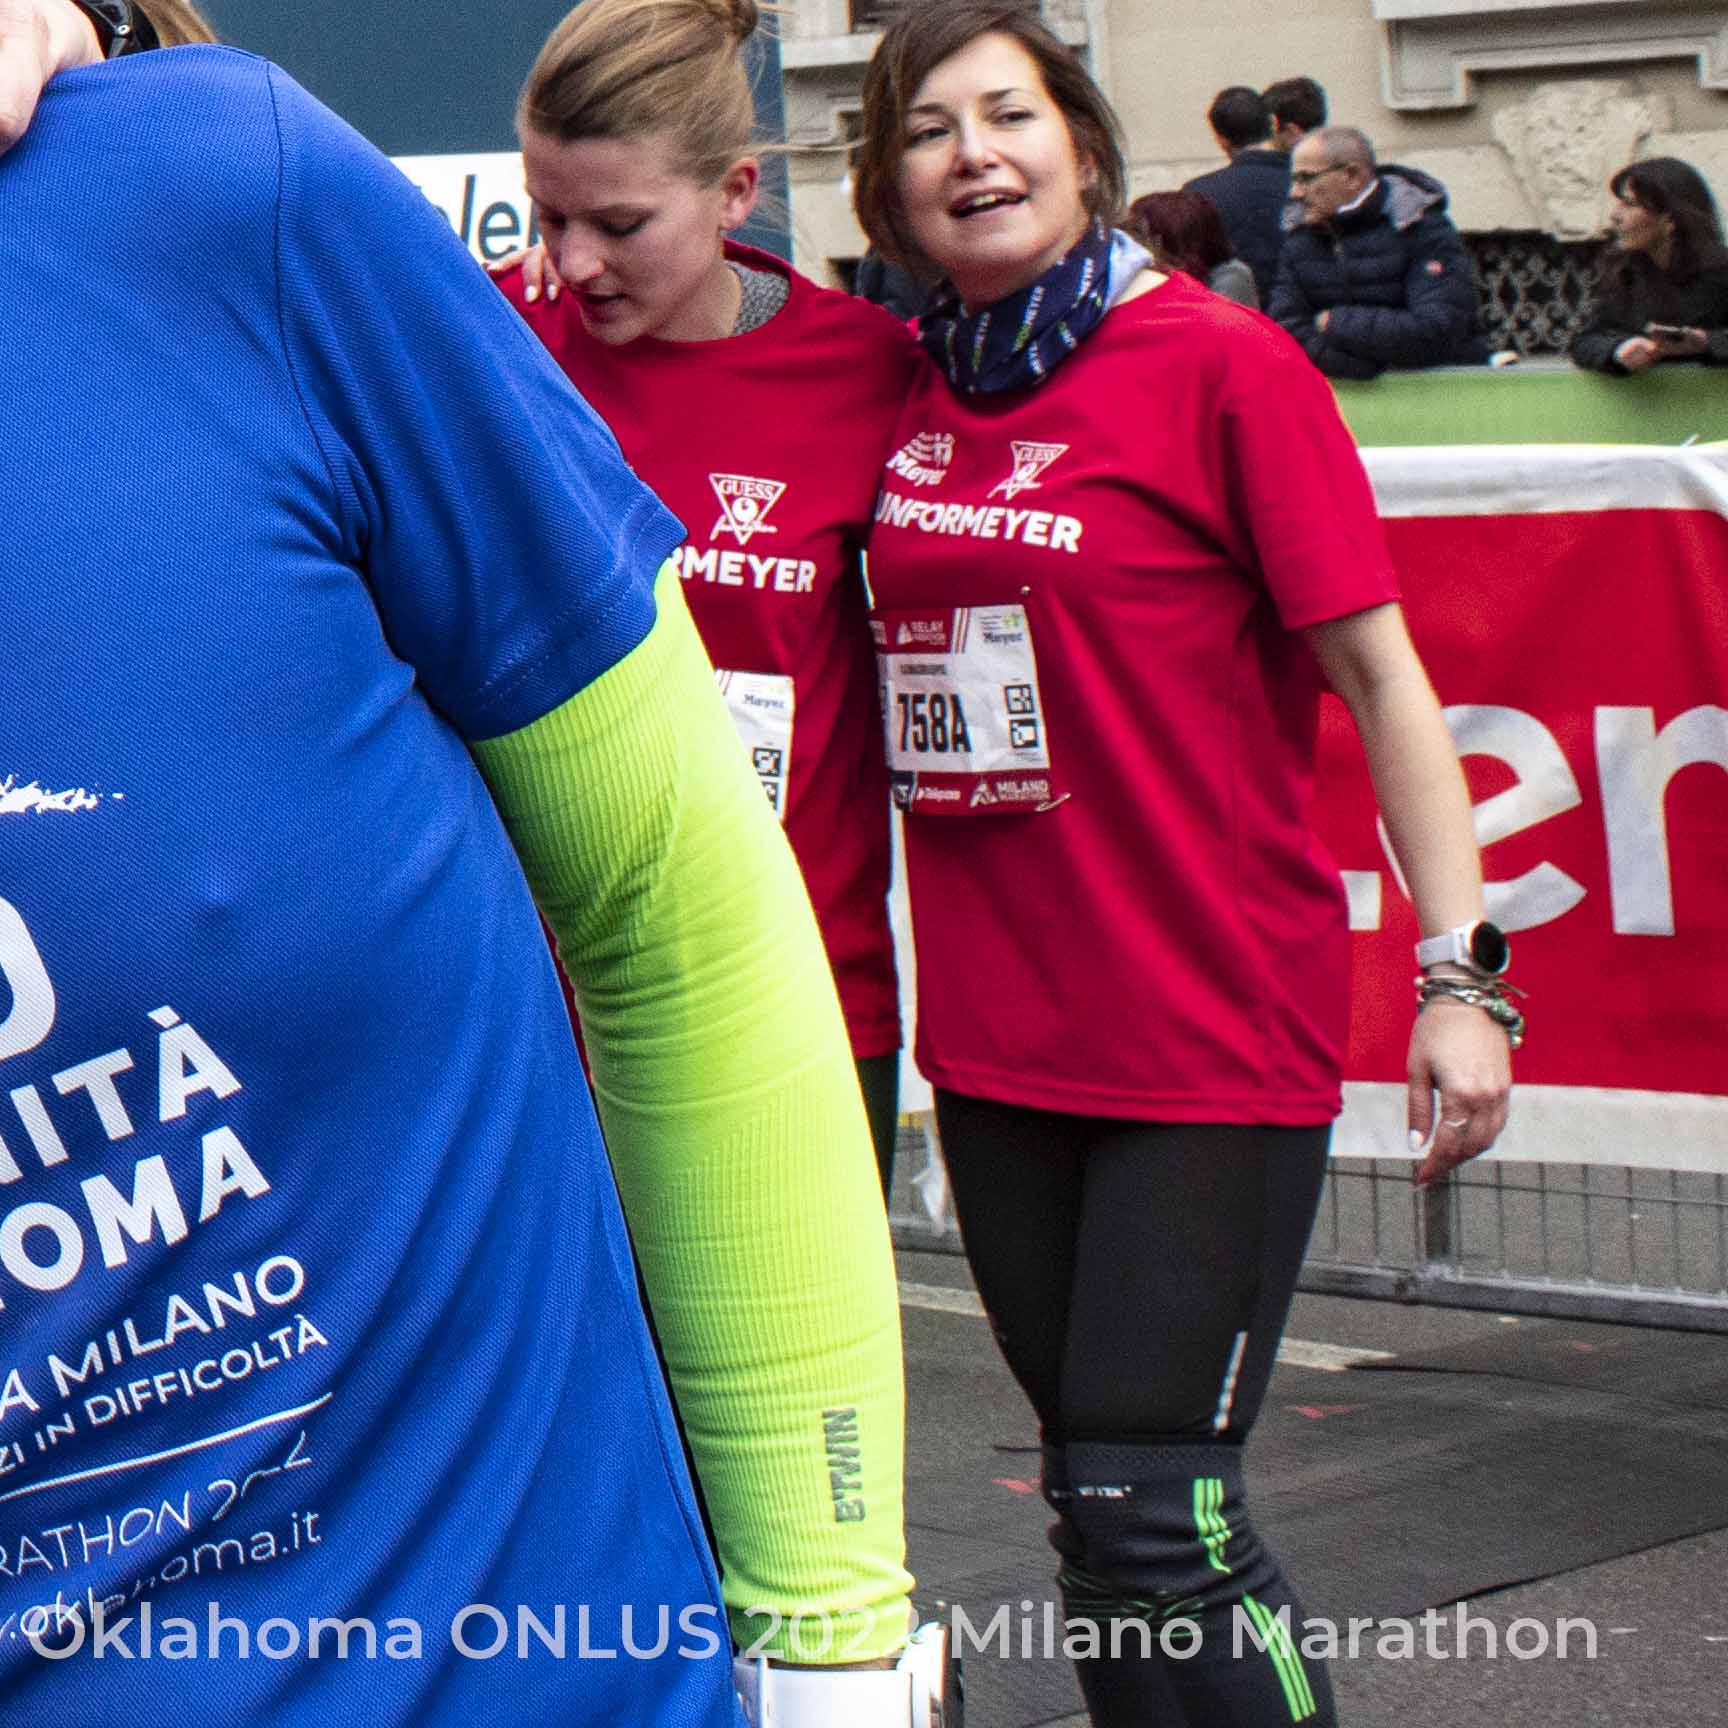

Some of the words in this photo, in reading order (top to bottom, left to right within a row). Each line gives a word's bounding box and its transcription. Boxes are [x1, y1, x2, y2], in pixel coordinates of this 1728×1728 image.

[720, 479, 776, 501] GUESS
[896, 692, 974, 754] 758A
[46, 1254, 305, 1398] MILANO
[39, 1412, 76, 1454] IN
[87, 1313, 329, 1428] DIFFICOLTÀ
